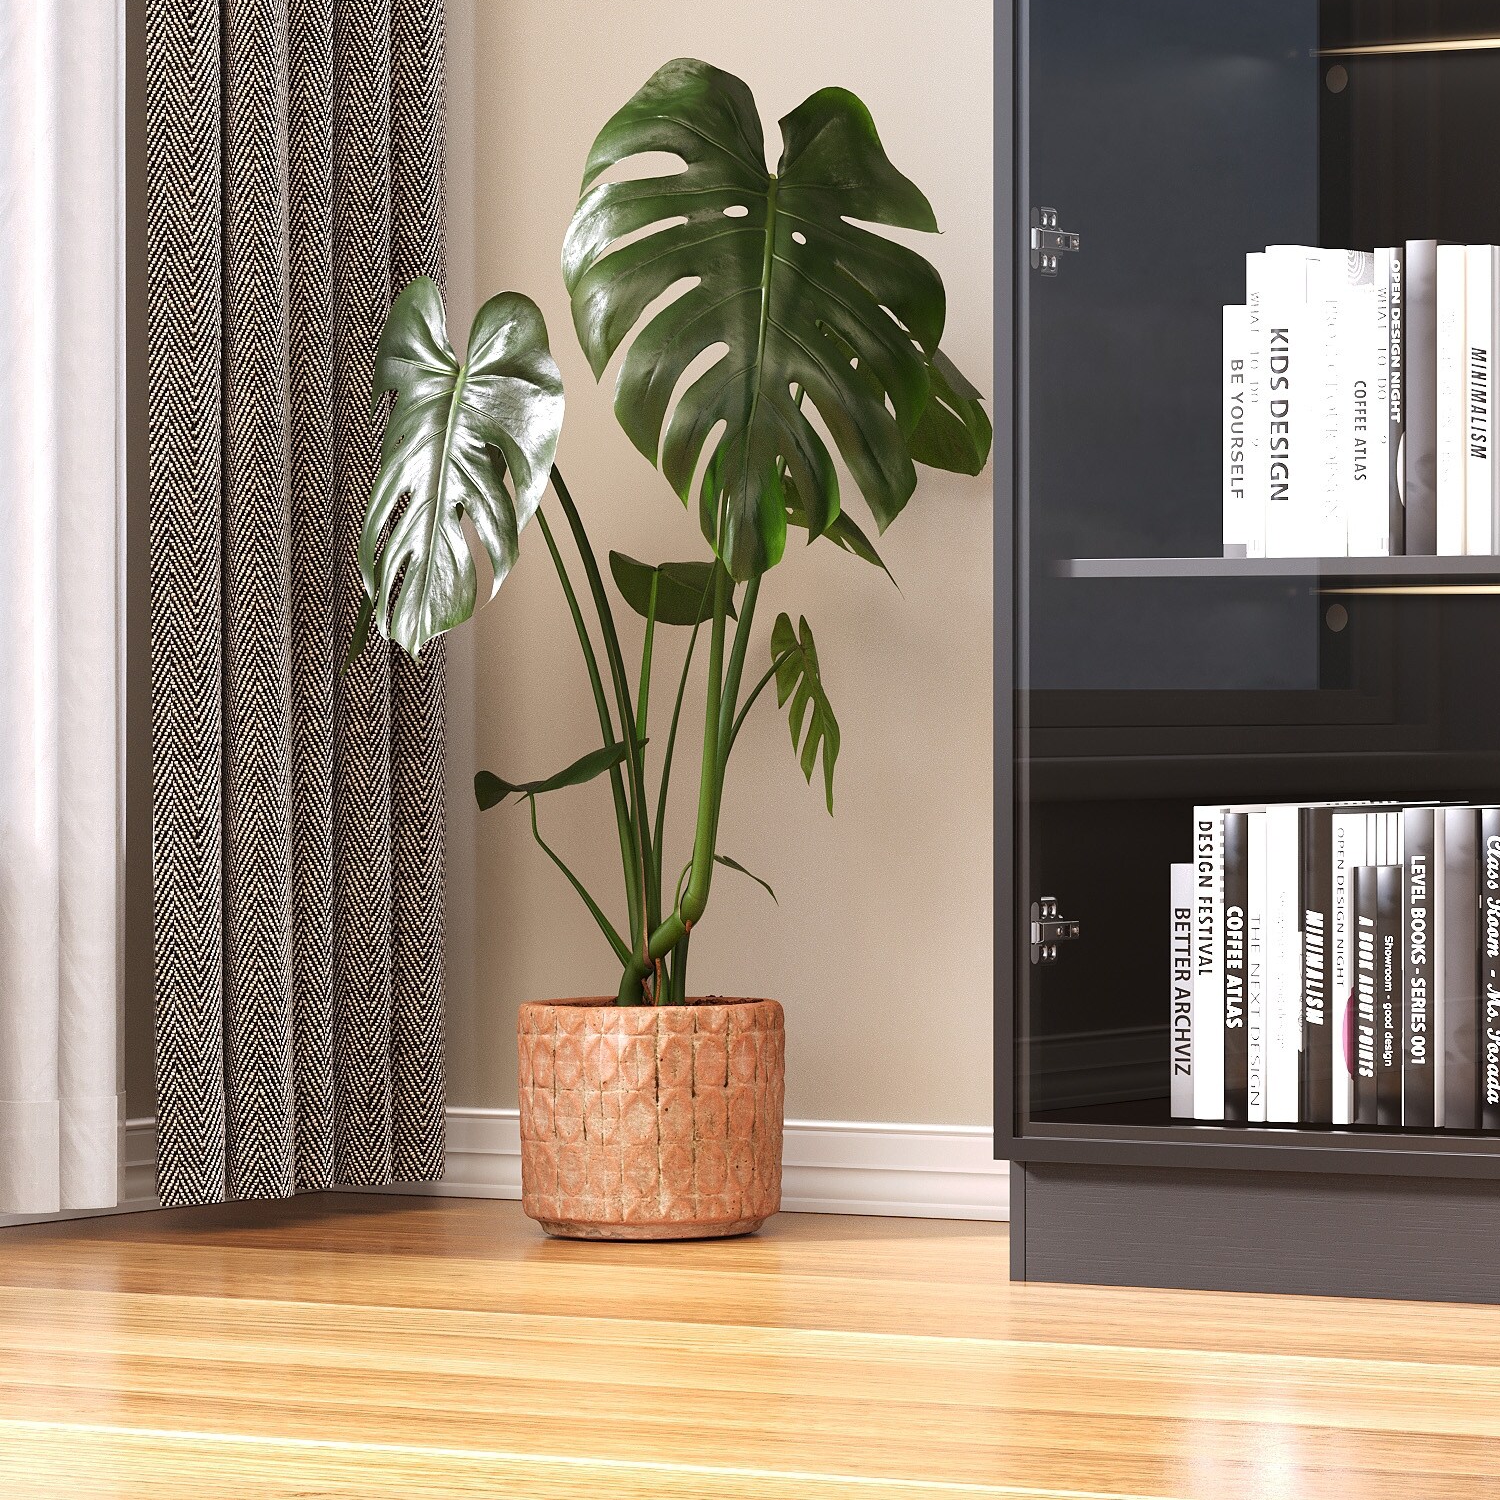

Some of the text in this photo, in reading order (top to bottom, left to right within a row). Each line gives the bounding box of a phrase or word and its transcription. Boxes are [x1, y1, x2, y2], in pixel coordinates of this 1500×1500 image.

[1391, 259, 1401, 424] OPEN DESIGN NIGHT
[1230, 359, 1244, 499] BE YOURSELF
[1270, 328, 1289, 501] KIDS DESIGN
[1354, 380, 1367, 481] COFFEE ATLAS
[1470, 347, 1487, 460] MINIMALISM
[1198, 820, 1213, 976] DESIGN FESTIVAL
[1336, 827, 1345, 988] OPEN DESIGN NIGHT
[1410, 907, 1427, 965] BOOKS
[1411, 855, 1426, 905] LEVEL
[1174, 908, 1191, 1076] BETTER ARCHVIZ
[1226, 905, 1244, 1029] COFFEE ATLAS
[1250, 914, 1261, 1106] THE NEXT DESIGN
[1305, 909, 1324, 1026] MINIMALISM
[1358, 915, 1374, 1078] A BOOK ABOUT POINTS
[1382, 1002, 1393, 1029] good
[1384, 935, 1393, 992] Showroom
[1410, 977, 1427, 1033] SERIES
[1382, 1031, 1393, 1067] design
[1411, 1035, 1426, 1065] 001
